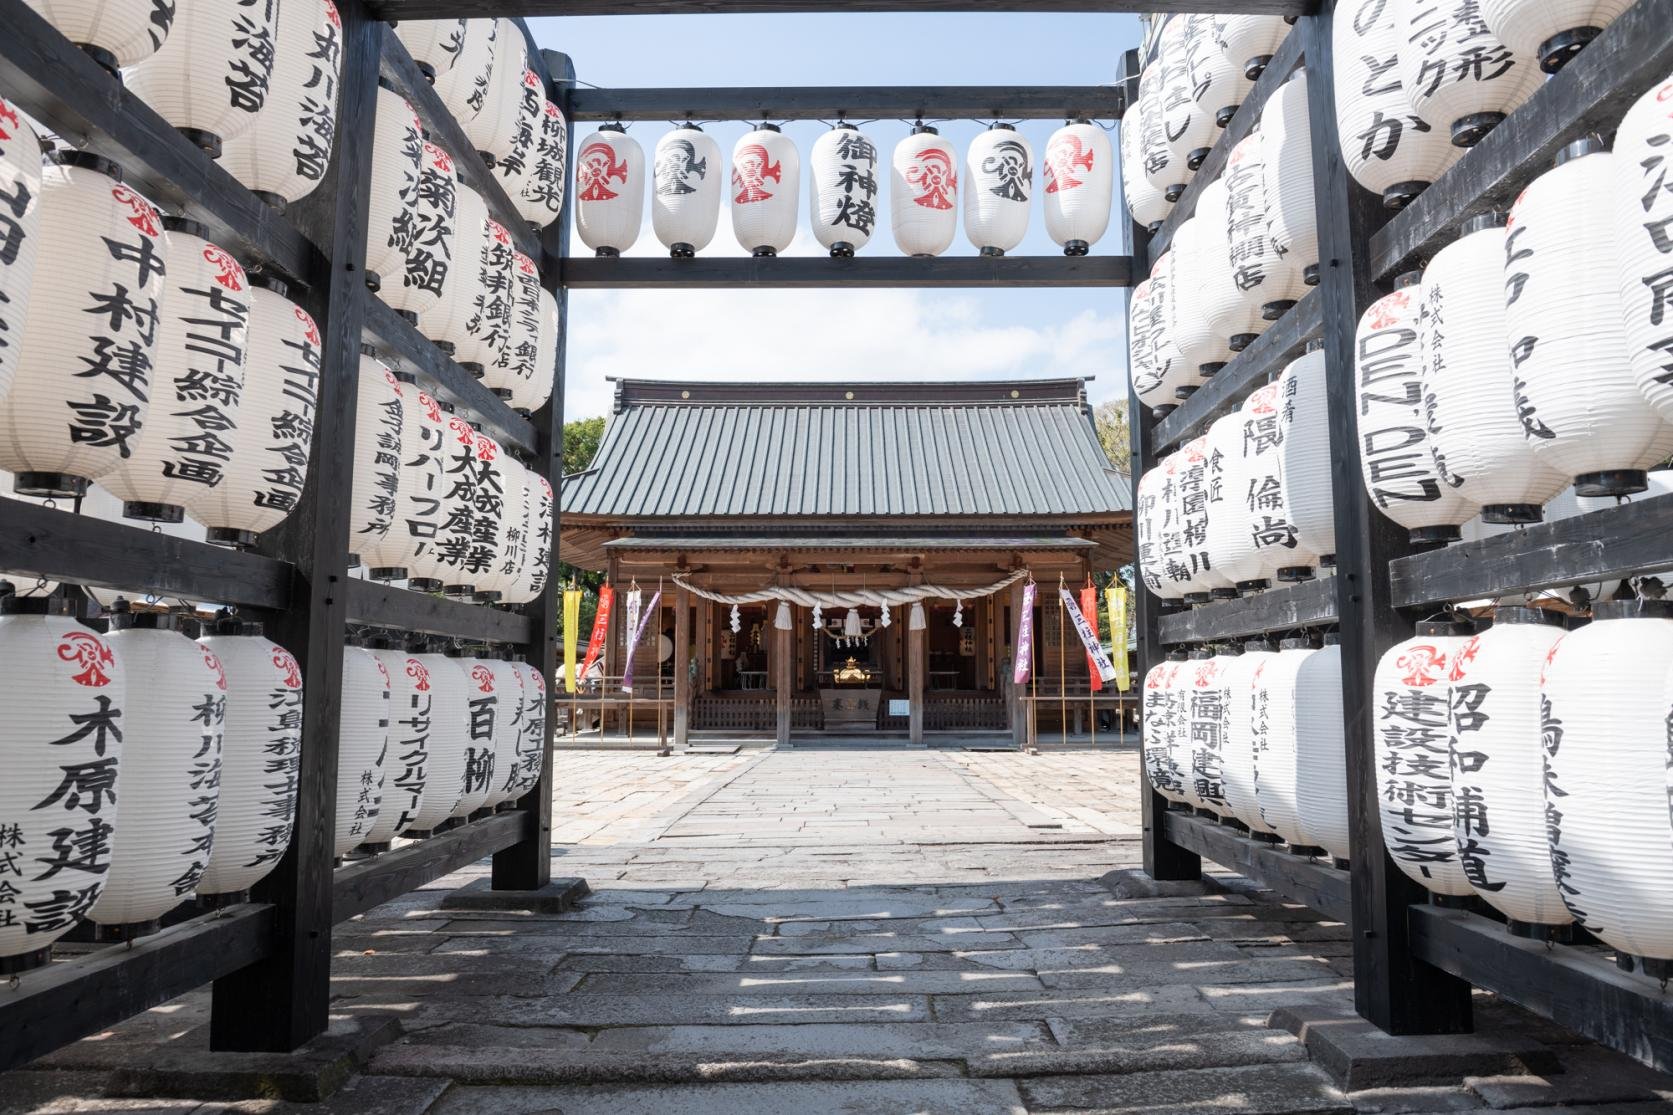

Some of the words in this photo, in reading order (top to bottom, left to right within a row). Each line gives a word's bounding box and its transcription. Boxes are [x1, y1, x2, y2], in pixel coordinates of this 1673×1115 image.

[404, 168, 457, 298] 菊次組
[831, 132, 877, 237] 御神燈
[66, 234, 166, 459] 中村建設
[1429, 283, 1447, 373] 株式会社
[161, 286, 249, 488] セイコー綜合企画
[435, 445, 477, 566] 大成産業
[460, 461, 504, 574] 大成産業
[1209, 447, 1225, 503] 食匠
[499, 526, 520, 576] 柳川店
[394, 694, 431, 831] リサイクルマート
[466, 696, 498, 794] 百柳
[1258, 688, 1270, 751] 株式会社
[25, 695, 123, 934] 木原建設
[349, 770, 373, 835] 株式会社
[1380, 689, 1458, 878] 建設技術センター
[0, 822, 26, 927] 株式会社
